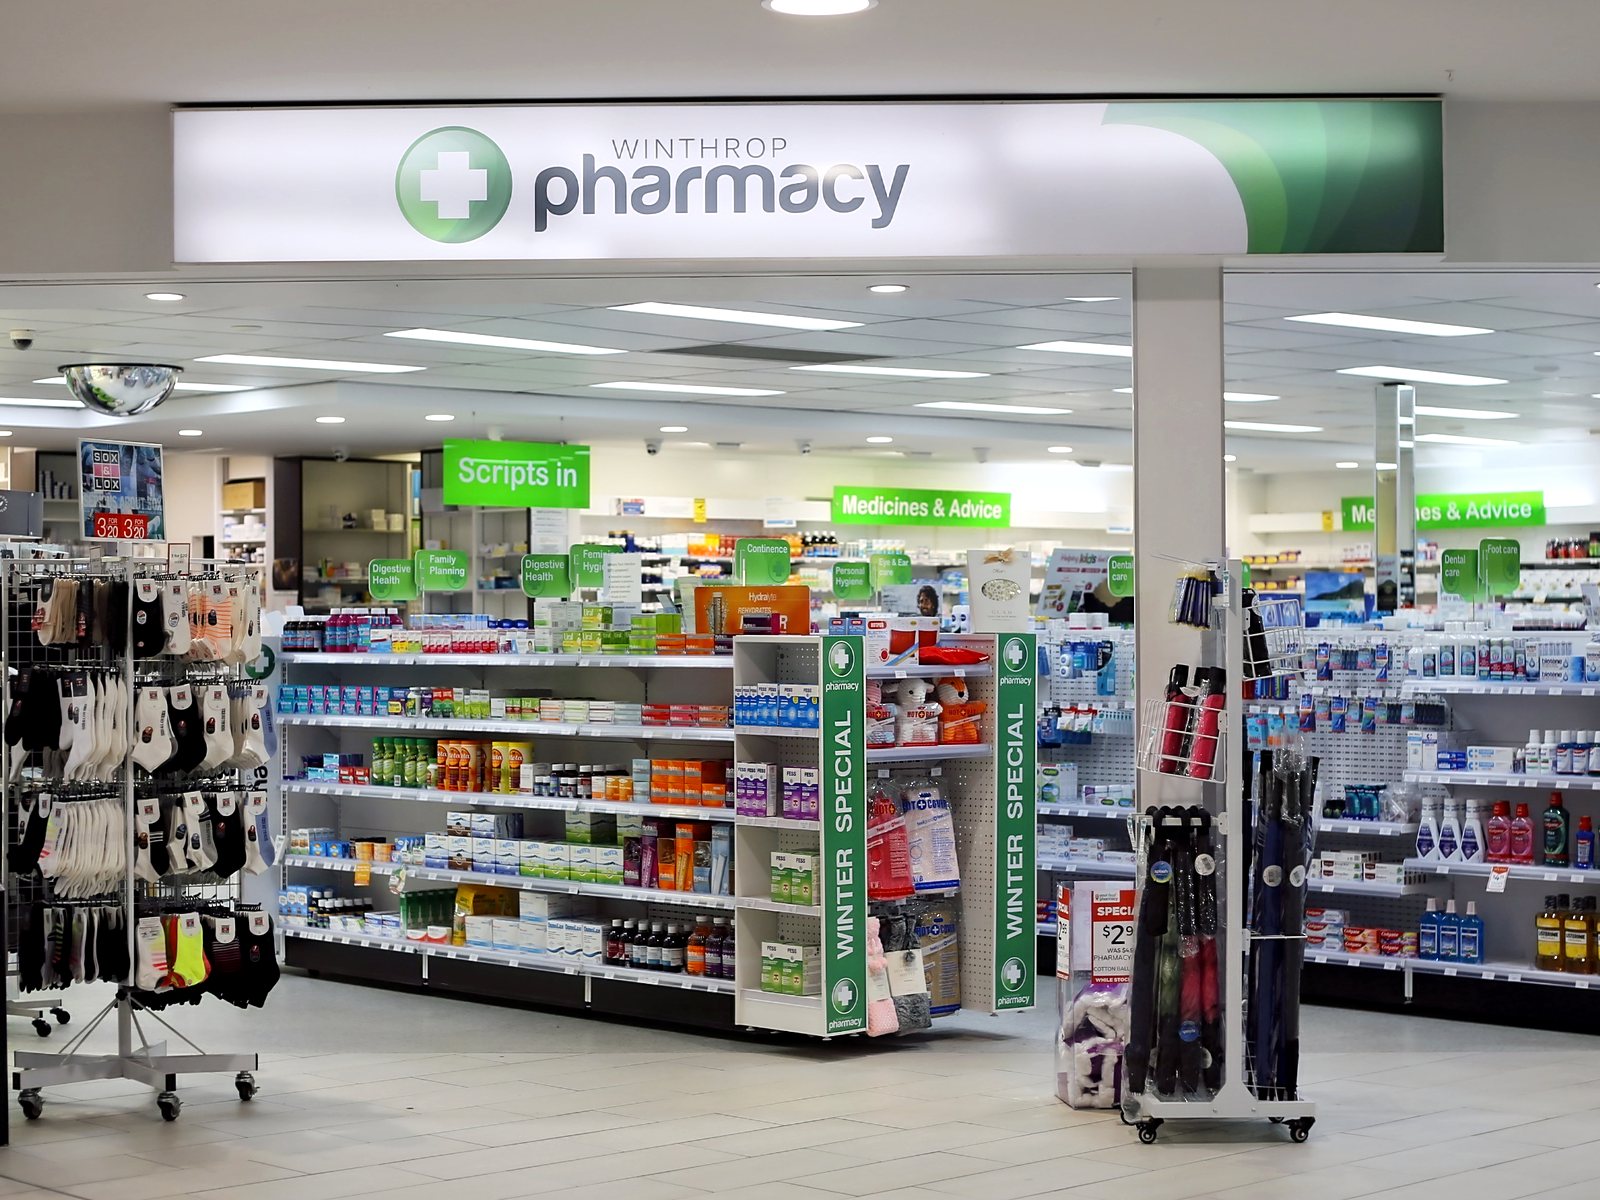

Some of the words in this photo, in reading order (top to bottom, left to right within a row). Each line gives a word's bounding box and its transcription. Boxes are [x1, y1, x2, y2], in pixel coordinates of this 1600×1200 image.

[612, 138, 788, 159] WINTHROP
[534, 153, 910, 232] pharmacy
[94, 453, 118, 462] SOX
[103, 466, 110, 475] &
[459, 457, 549, 491] Scripts
[556, 461, 577, 487] in
[95, 480, 119, 489] LOX
[842, 494, 928, 517] Medicines
[932, 497, 945, 516] &
[949, 499, 1002, 520] Advice
[1447, 501, 1460, 520] &
[1466, 502, 1532, 519] Advice
[97, 517, 107, 537] 3
[124, 519, 132, 538] 3
[747, 544, 788, 554] Continence
[1487, 544, 1502, 554] Foot
[1503, 546, 1518, 554] care
[429, 554, 457, 565] Family
[1444, 554, 1466, 564] Dental
[372, 564, 411, 575] Digestive
[526, 560, 565, 570] Digestive
[429, 566, 465, 577] Planning
[525, 572, 553, 581] Health
[835, 567, 865, 575] Personal
[372, 575, 400, 584] Health
[835, 578, 864, 587] Hygiene
[1112, 573, 1128, 581] care
[1000, 677, 1032, 686] pharmacy
[825, 682, 859, 693] pharmacy
[1007, 703, 1024, 819] SPECIAL
[834, 710, 853, 832] SPECIAL
[1007, 834, 1023, 939] WINTER
[836, 848, 854, 960] WINTER
[998, 996, 1030, 1007] pharmacy
[828, 1018, 862, 1032] pharmacy
